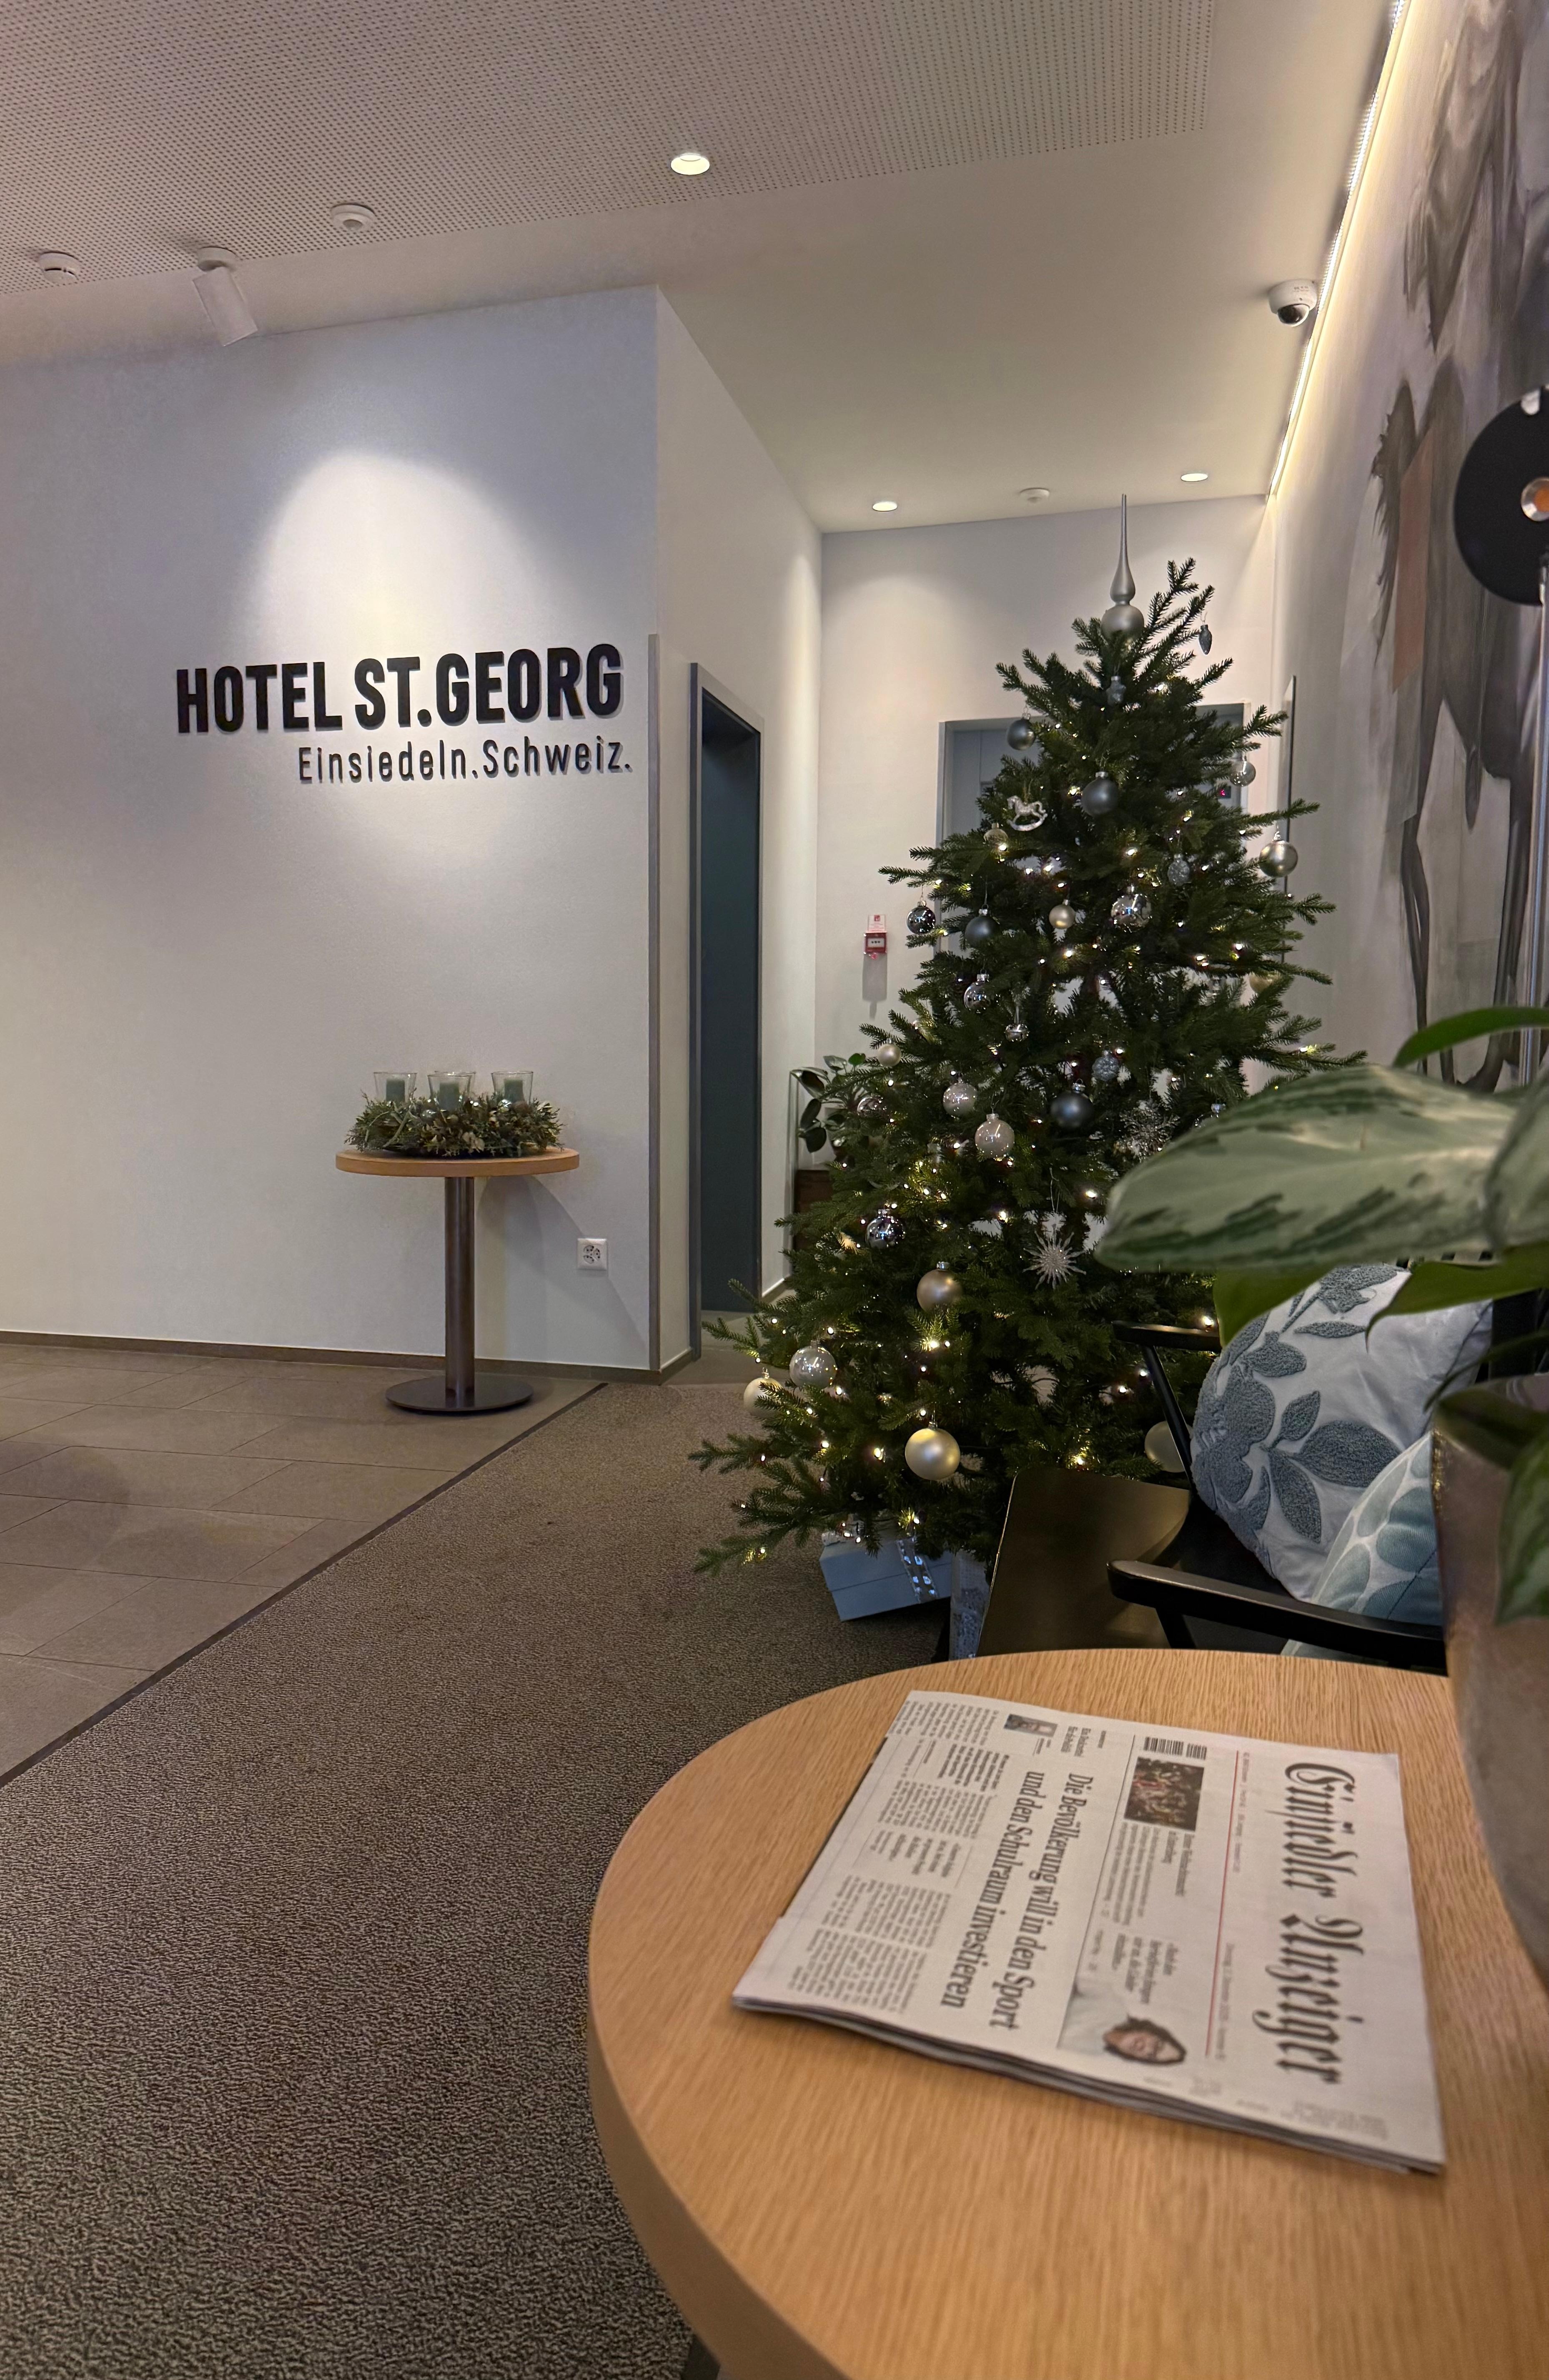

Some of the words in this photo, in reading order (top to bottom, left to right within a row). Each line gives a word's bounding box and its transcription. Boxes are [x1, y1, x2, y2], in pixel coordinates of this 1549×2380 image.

[176, 663, 343, 734] HOTEL
[354, 643, 622, 728] ST.GEORG
[298, 735, 631, 783] Einsiedeln.Schweiz.
[1019, 1771, 1046, 1798] und
[1064, 1773, 1094, 1795] Die
[1010, 1797, 1043, 1823] den
[979, 1823, 1033, 1904] Schulraum
[1029, 1795, 1087, 1885] Bevölkerung
[1019, 1914, 1053, 1935] in
[1025, 1885, 1059, 1917] will
[940, 1904, 1005, 2009] investieren
[1008, 1935, 1047, 1971] den
[989, 1971, 1035, 2031] Sport
[1252, 1913, 1364, 2084] Anzeiger
